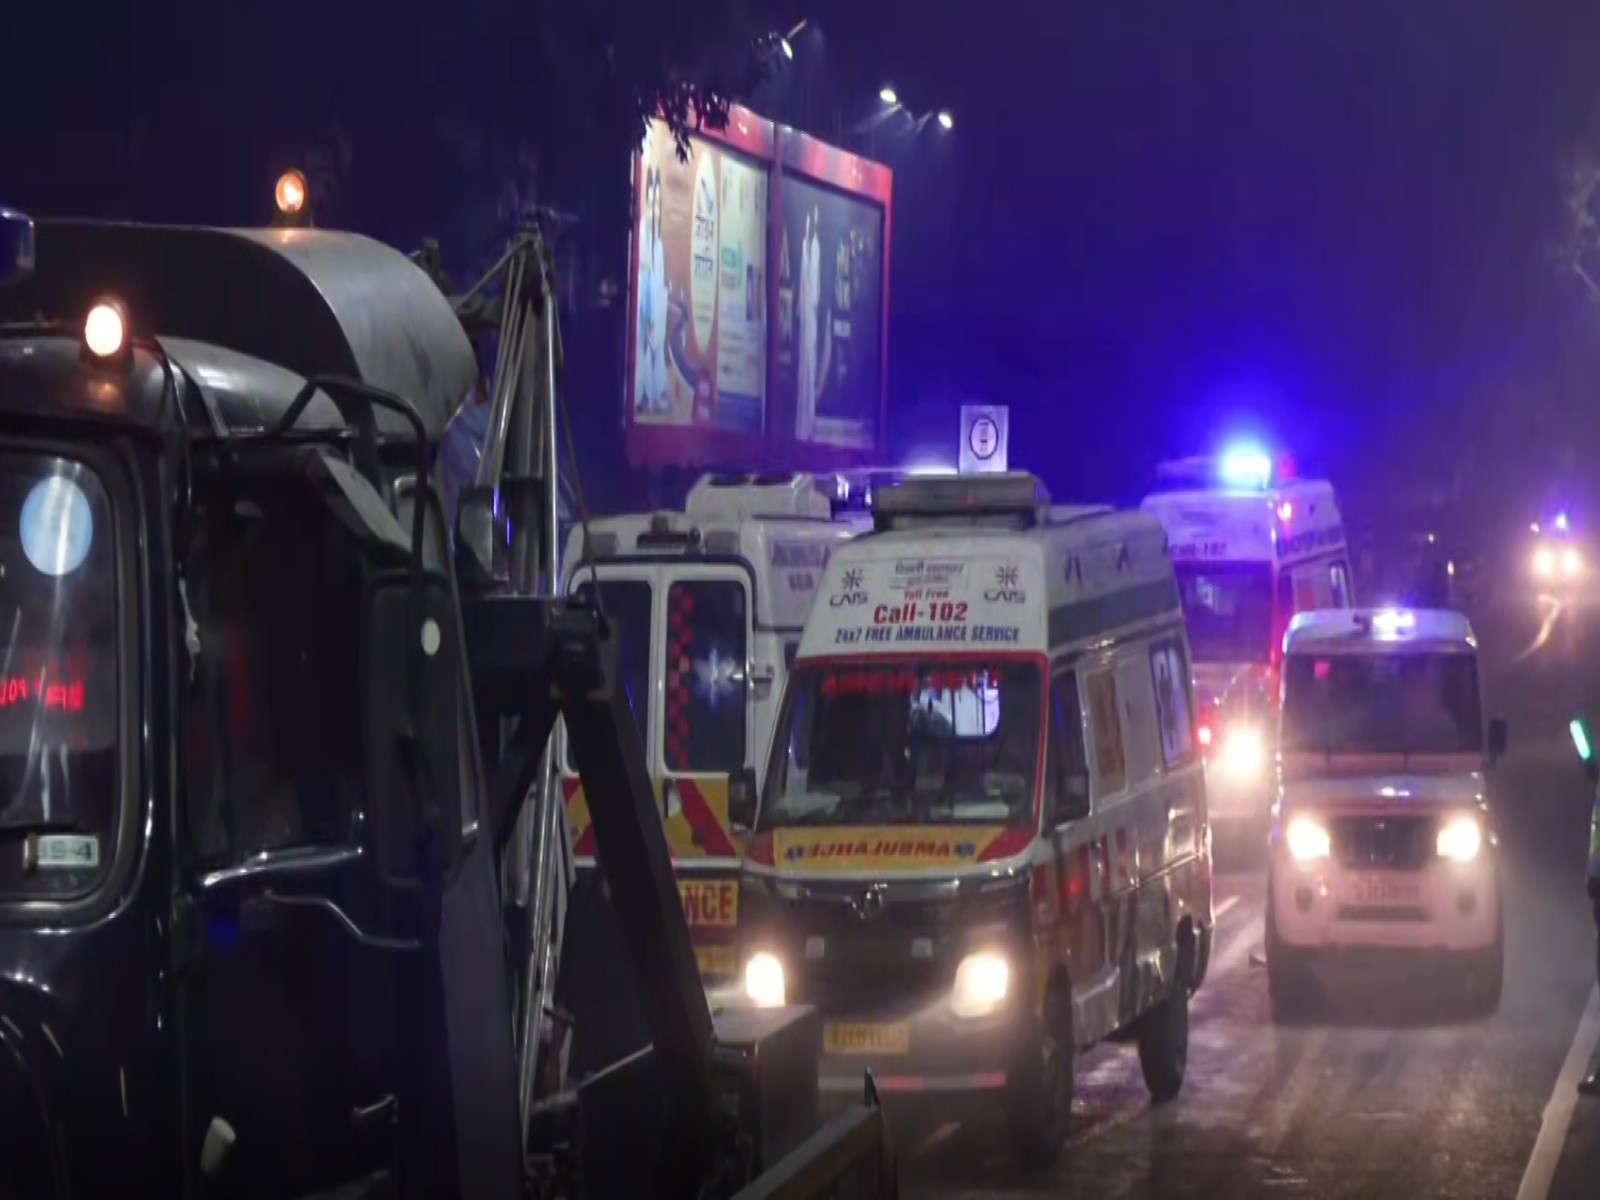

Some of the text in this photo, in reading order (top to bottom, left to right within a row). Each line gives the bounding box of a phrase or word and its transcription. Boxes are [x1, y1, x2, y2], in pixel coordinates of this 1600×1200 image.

[874, 602, 968, 623] Call-102
[865, 626, 892, 641] FREE
[895, 625, 967, 641] AMBULANCE
[971, 624, 1020, 643] SERVICE
